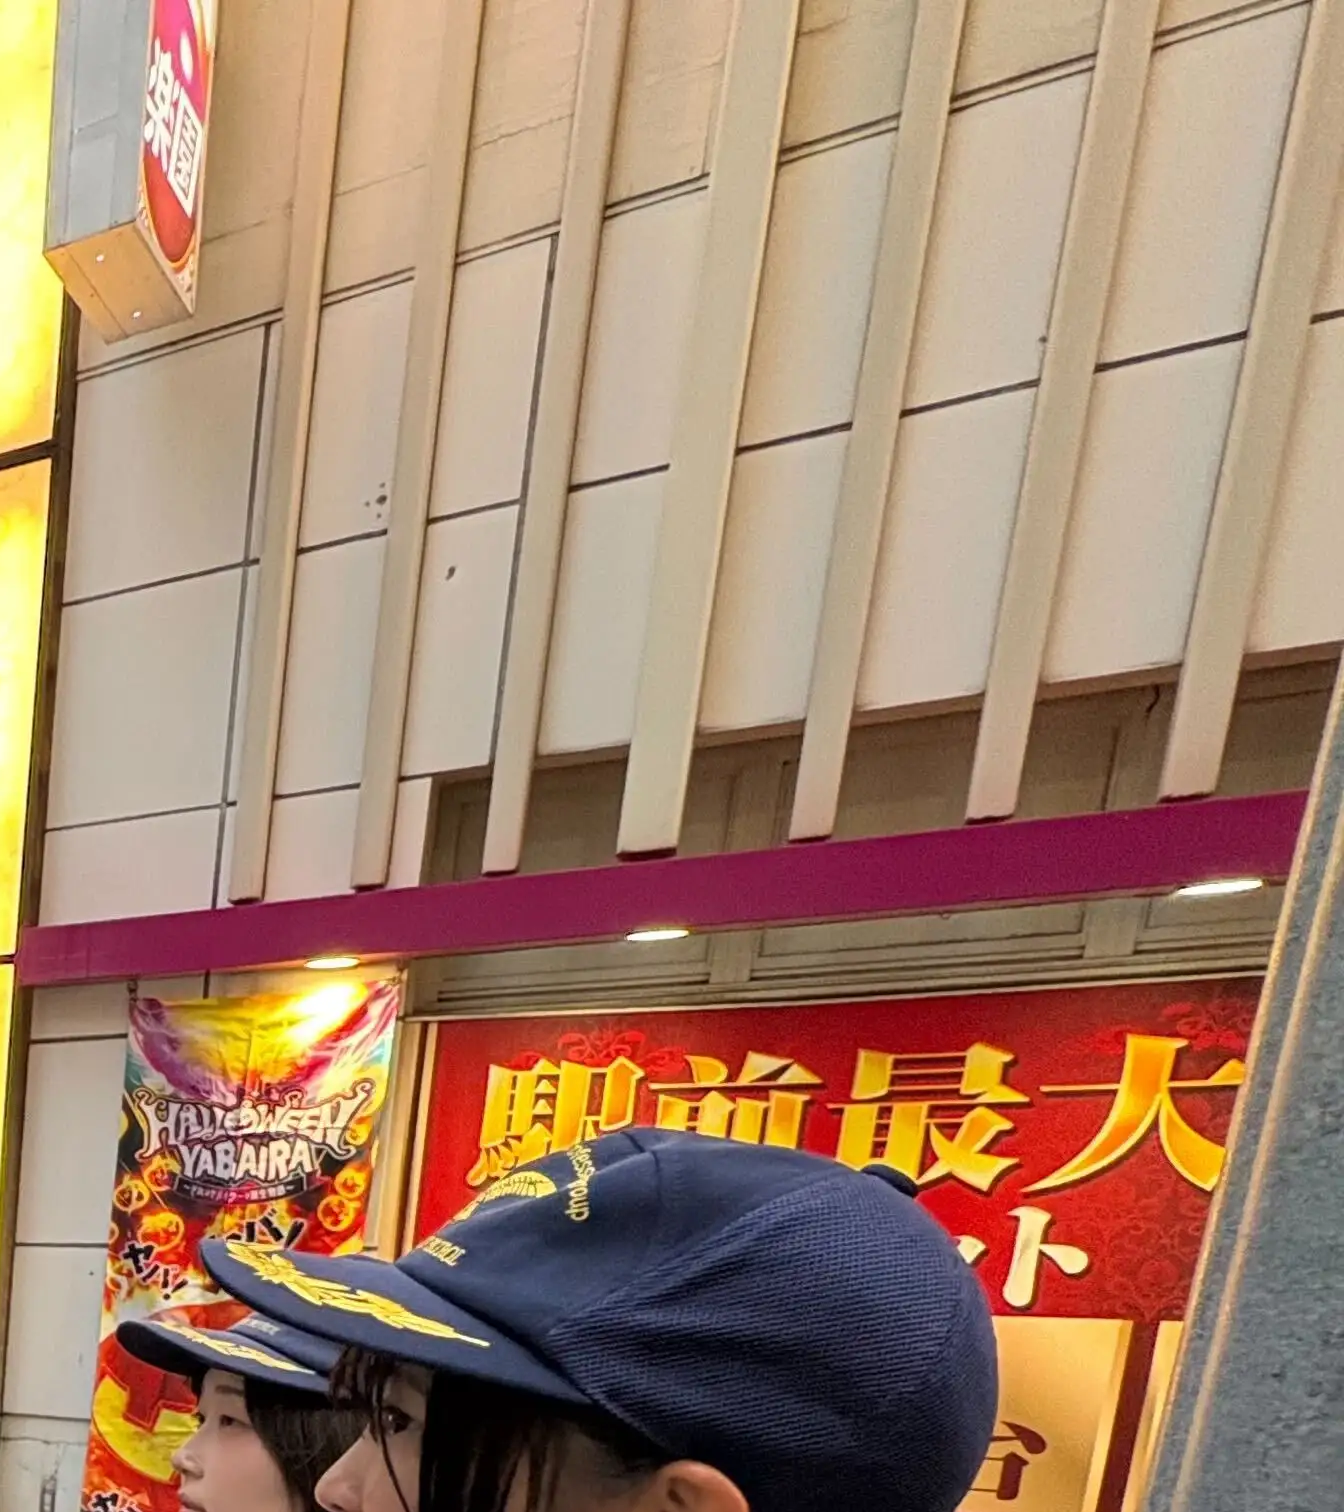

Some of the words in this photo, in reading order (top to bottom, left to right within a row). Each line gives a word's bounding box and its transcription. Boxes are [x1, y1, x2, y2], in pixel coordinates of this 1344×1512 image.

[143, 36, 204, 219] 楽園
[134, 1079, 375, 1162] HALLOWEEN
[180, 1139, 317, 1181] YABAIRA
